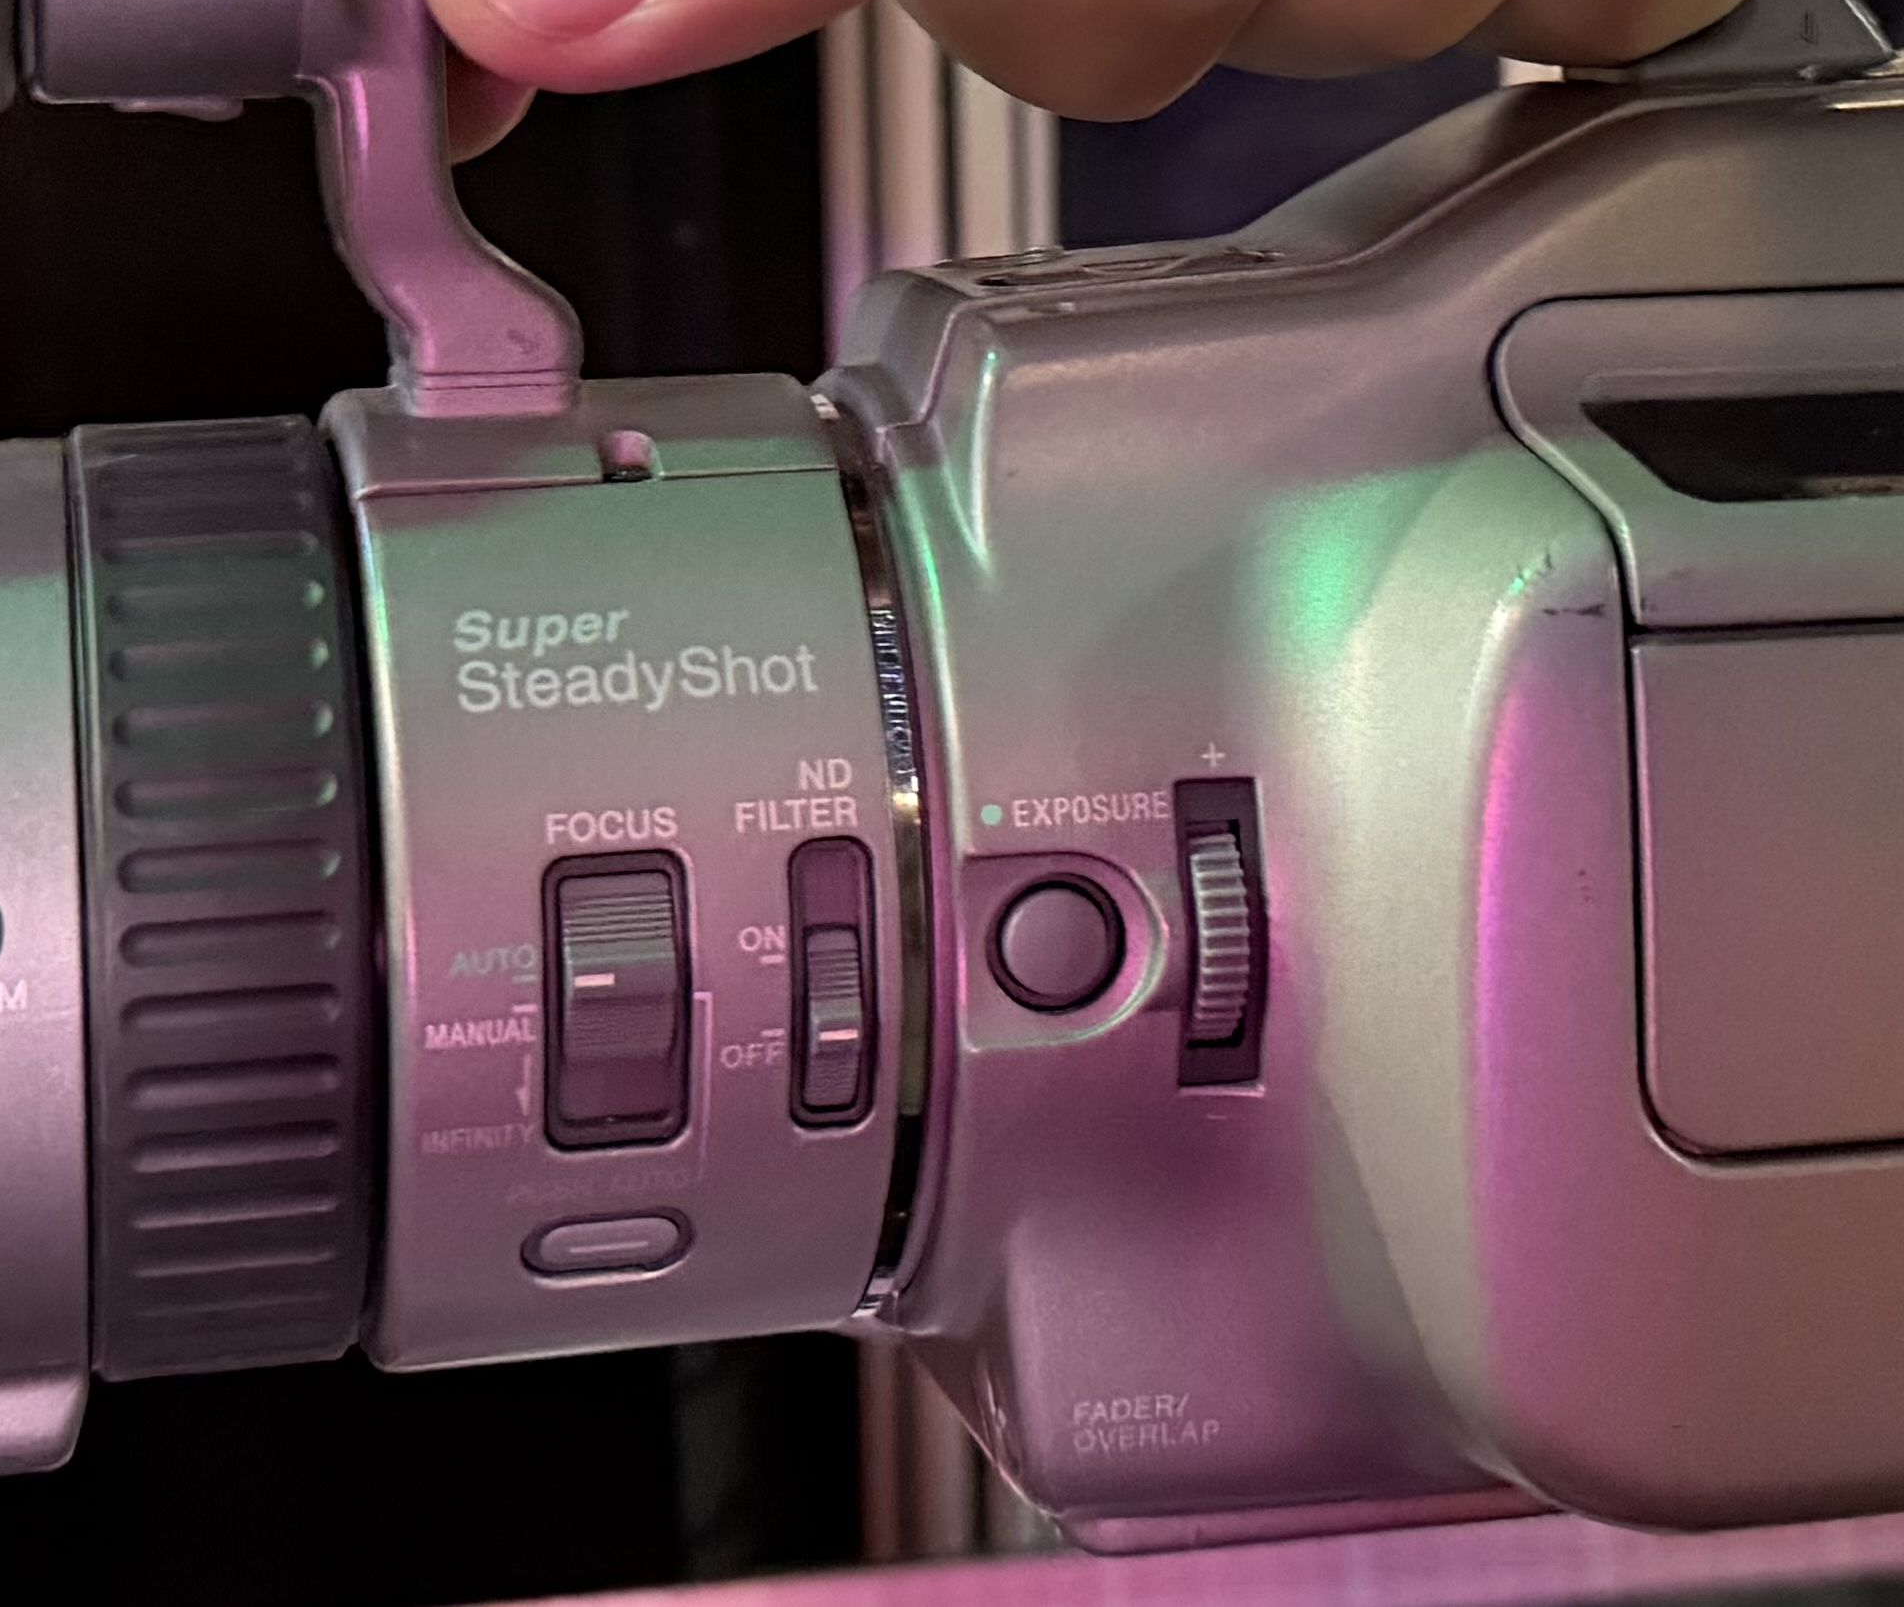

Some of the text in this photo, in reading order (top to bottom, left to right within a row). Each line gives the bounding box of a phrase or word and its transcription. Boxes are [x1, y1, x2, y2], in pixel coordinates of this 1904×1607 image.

[453, 607, 631, 658] Super
[456, 644, 819, 713] SteadyShot
[798, 758, 853, 791] ND
[546, 806, 679, 845] FOCUS
[734, 796, 859, 834] FILTER
[1011, 791, 1172, 828] EXPOSURE
[737, 925, 786, 952] ON
[450, 944, 536, 978] AUTO
[423, 1017, 537, 1050] MANUAL
[719, 1041, 786, 1069] OFF
[1073, 1393, 1191, 1426] FADER/
[1072, 1419, 1221, 1453] OVERLAP
